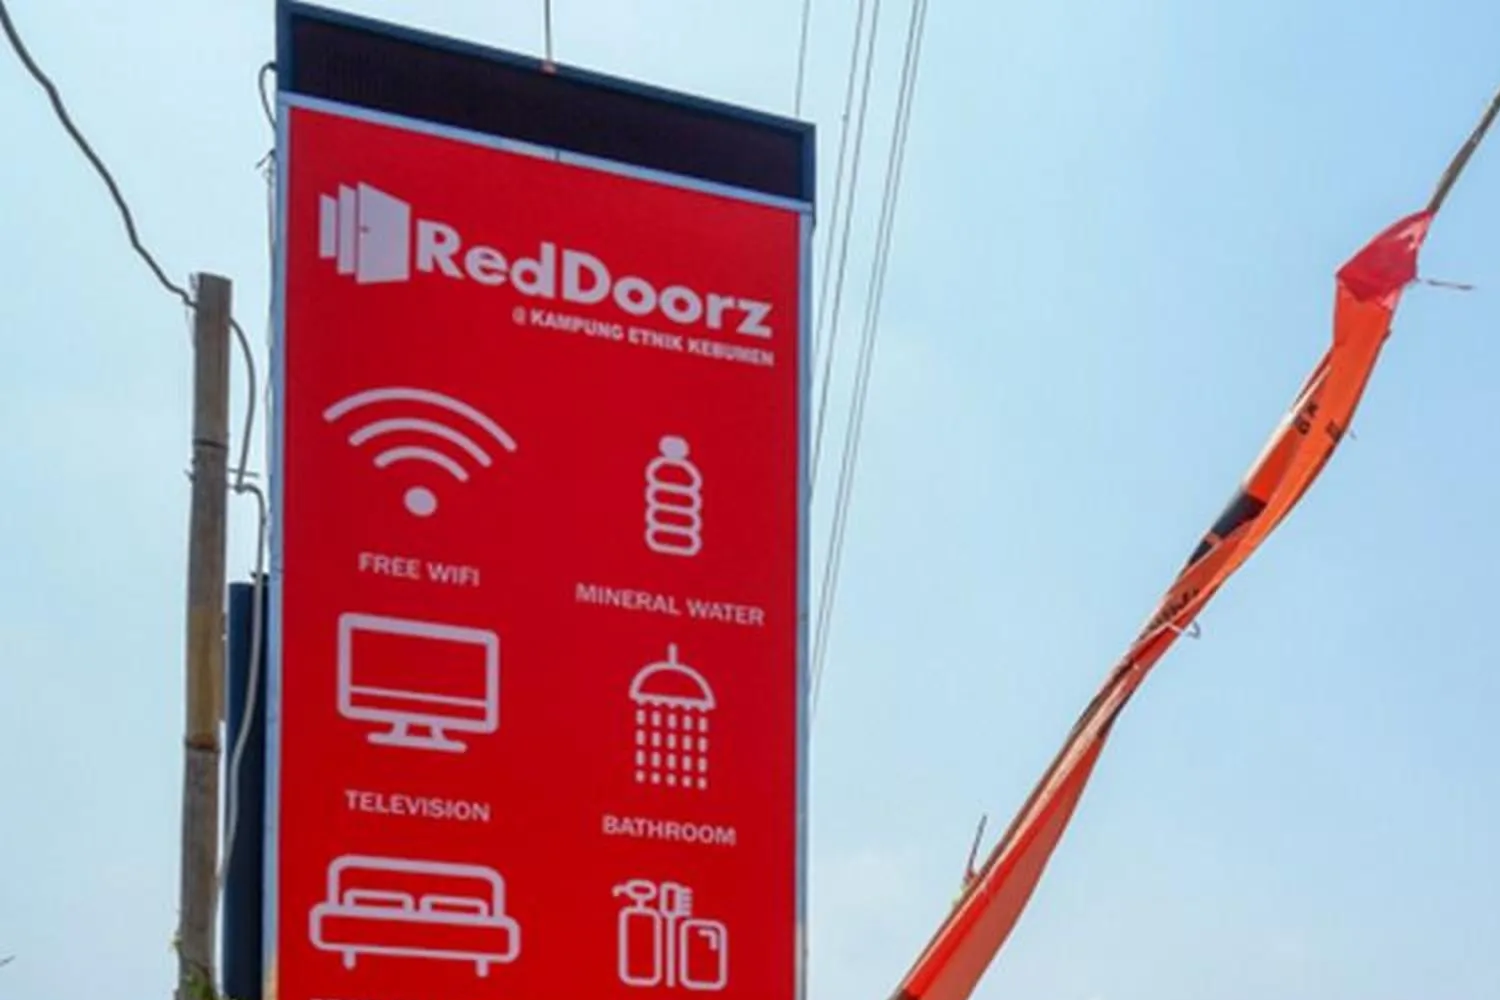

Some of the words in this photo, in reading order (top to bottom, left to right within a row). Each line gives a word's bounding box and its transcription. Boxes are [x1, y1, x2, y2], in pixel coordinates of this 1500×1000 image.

[416, 219, 773, 338] RedDoorz
[530, 309, 625, 341] KAMPUNG
[627, 327, 684, 353] ETNIK
[358, 552, 421, 580] FREE
[427, 562, 480, 587] WIFI
[575, 583, 680, 615] MINERAL
[686, 600, 765, 626] WATER
[344, 789, 491, 822] TELEVISION
[602, 814, 737, 845] BATHROOM
